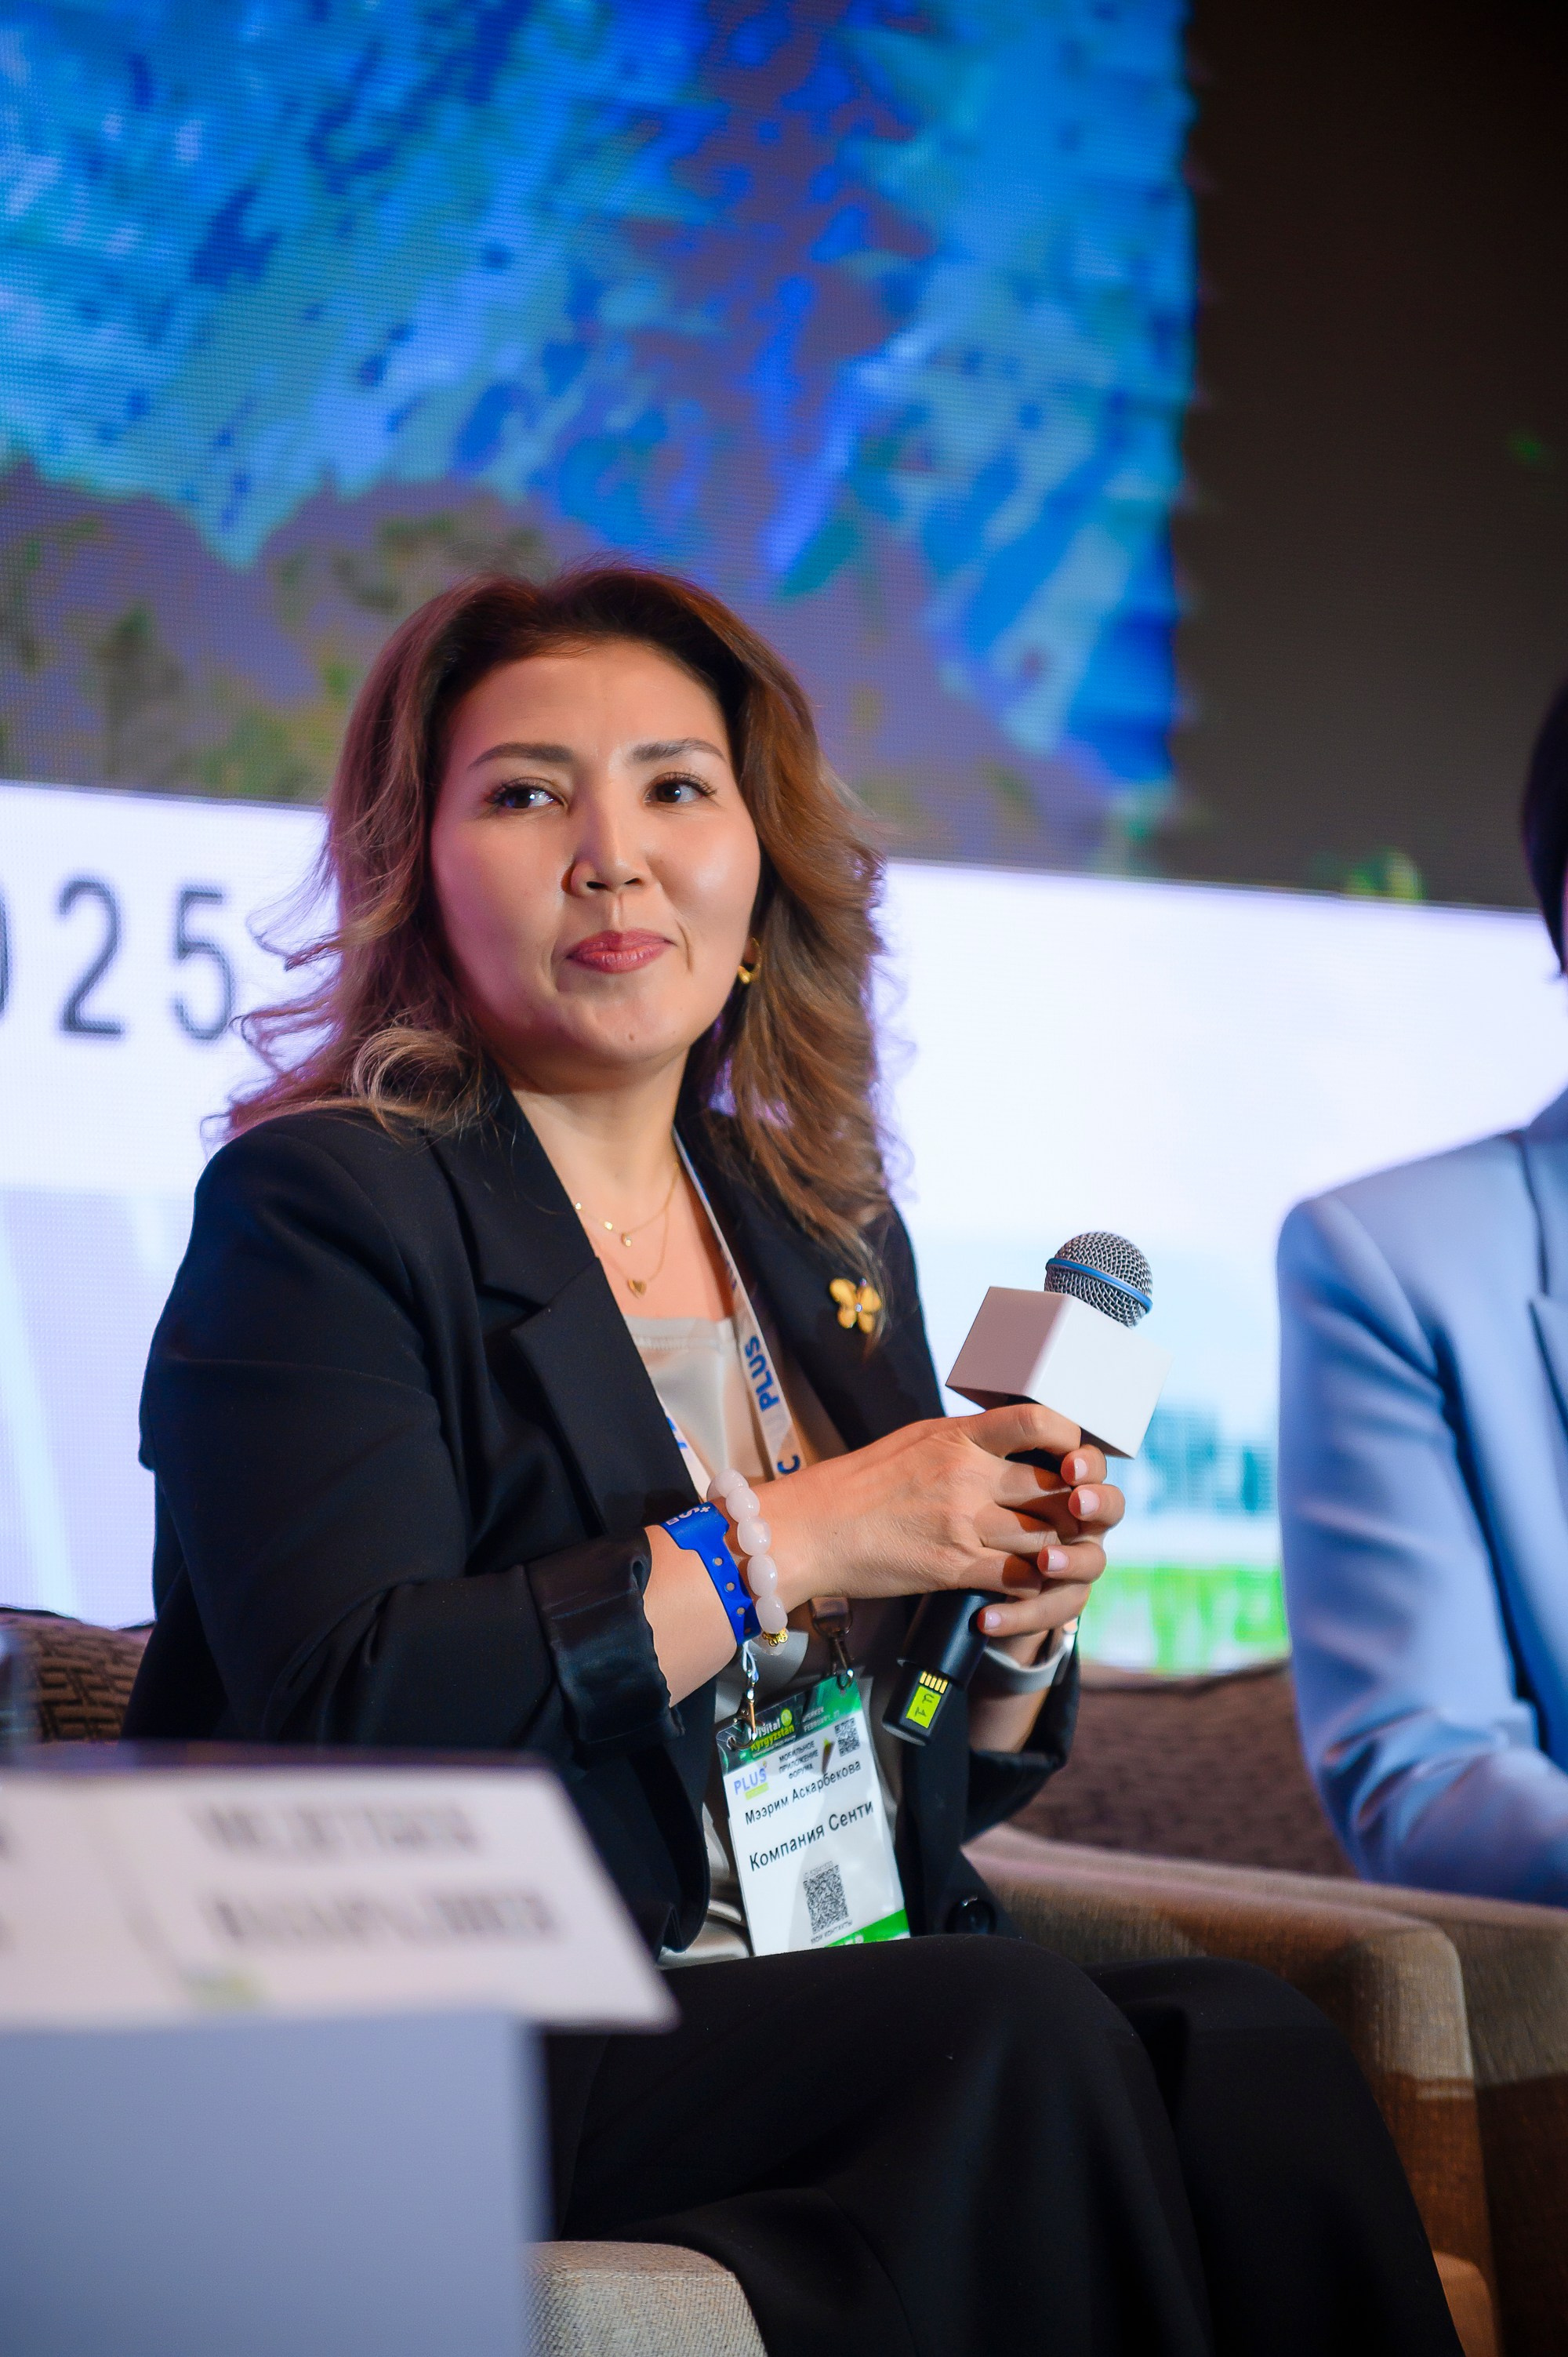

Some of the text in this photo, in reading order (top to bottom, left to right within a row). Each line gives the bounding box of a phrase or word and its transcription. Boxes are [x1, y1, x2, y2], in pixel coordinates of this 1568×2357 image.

[0, 877, 234, 1041] 25
[745, 1335, 781, 1412] PLUS
[733, 1767, 767, 1796] PLUS
[745, 1796, 789, 1825] Мээрим
[792, 1760, 862, 1803] Аскарбекова
[749, 1825, 826, 1872] Компания
[828, 1801, 874, 1832] Сенти
